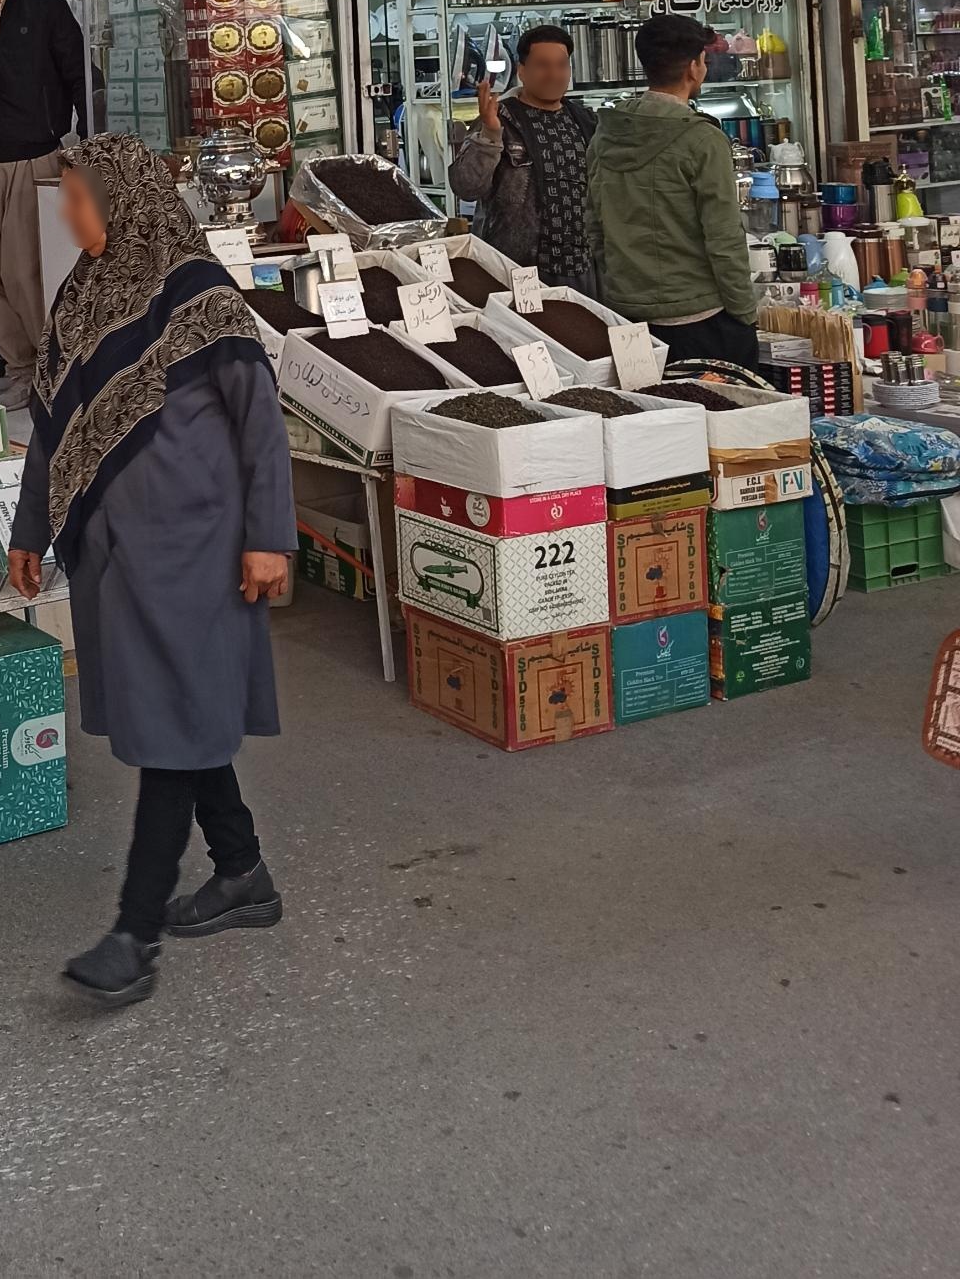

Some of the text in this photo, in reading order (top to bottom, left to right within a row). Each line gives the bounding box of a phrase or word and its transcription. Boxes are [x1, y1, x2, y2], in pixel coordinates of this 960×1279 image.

[534, 540, 576, 570] 222
[617, 534, 627, 569] STD
[687, 523, 696, 557] STD
[518, 657, 527, 694] STD
[592, 644, 602, 679] STD
[2, 728, 10, 770] Premium
